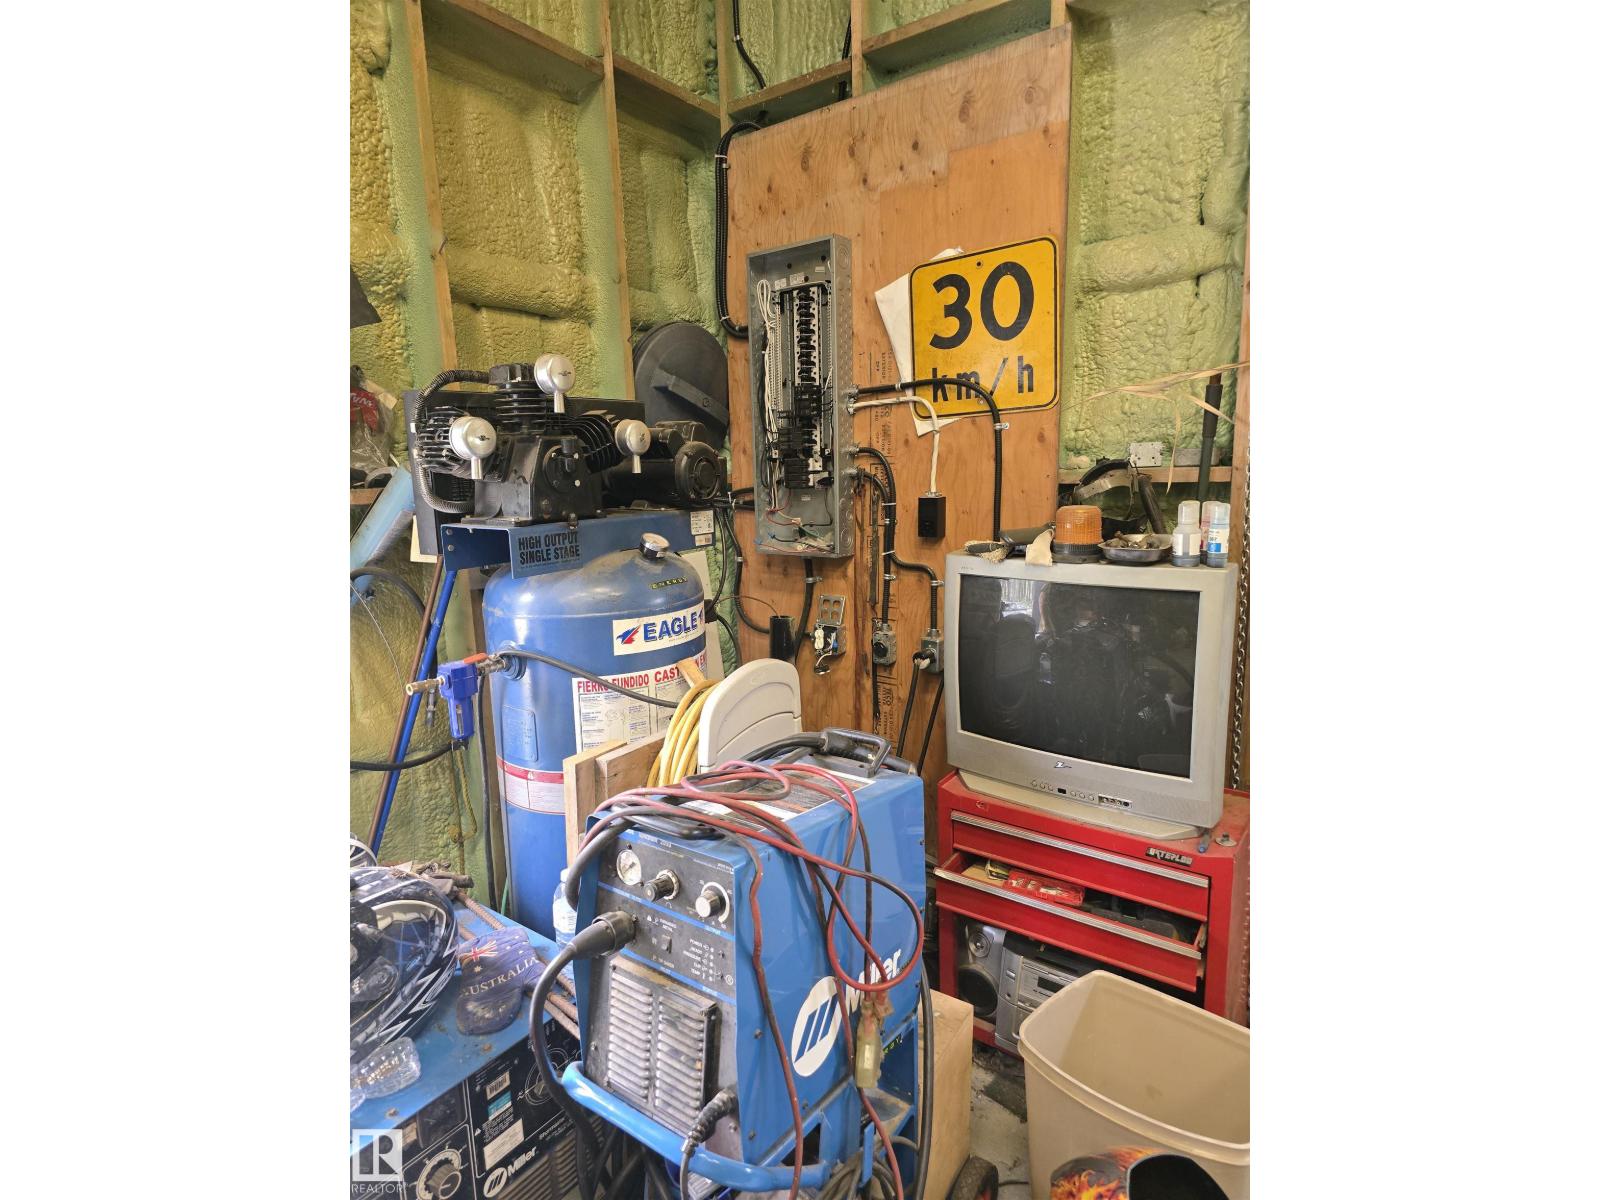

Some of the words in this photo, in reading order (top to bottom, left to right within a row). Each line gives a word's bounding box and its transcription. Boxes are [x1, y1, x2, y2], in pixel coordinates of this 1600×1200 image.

[929, 261, 1034, 349] 30
[931, 356, 1034, 402] km/h
[518, 536, 541, 551] HIGH
[544, 531, 578, 547] OUTPUT
[520, 549, 551, 565] SINGLE
[554, 545, 580, 559] STAGE
[643, 611, 698, 642] EAGLE
[577, 680, 609, 693] FIERR
[845, 949, 901, 1016] Mller
[508, 1147, 537, 1177] Miller
